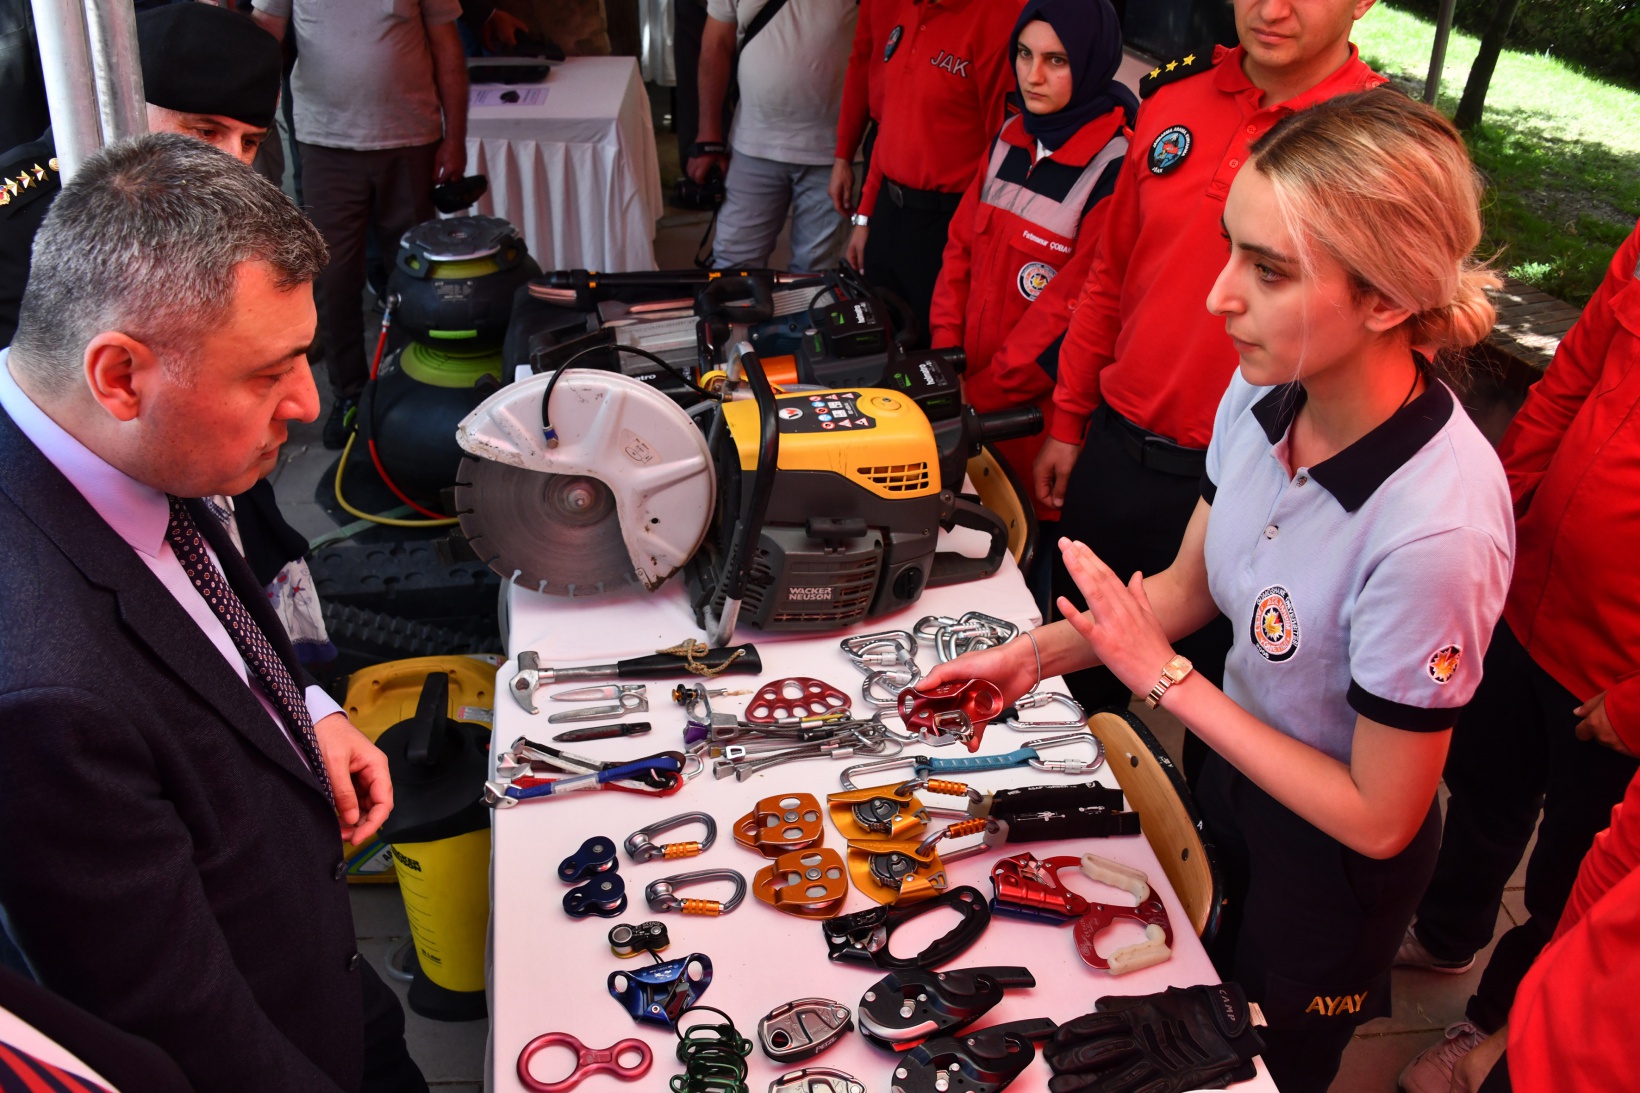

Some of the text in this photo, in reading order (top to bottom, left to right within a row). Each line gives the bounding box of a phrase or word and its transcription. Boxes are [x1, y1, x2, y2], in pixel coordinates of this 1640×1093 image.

[930, 50, 969, 78] JAK
[1219, 989, 1236, 1022] CAMP
[1304, 990, 1368, 1017] AYAY
